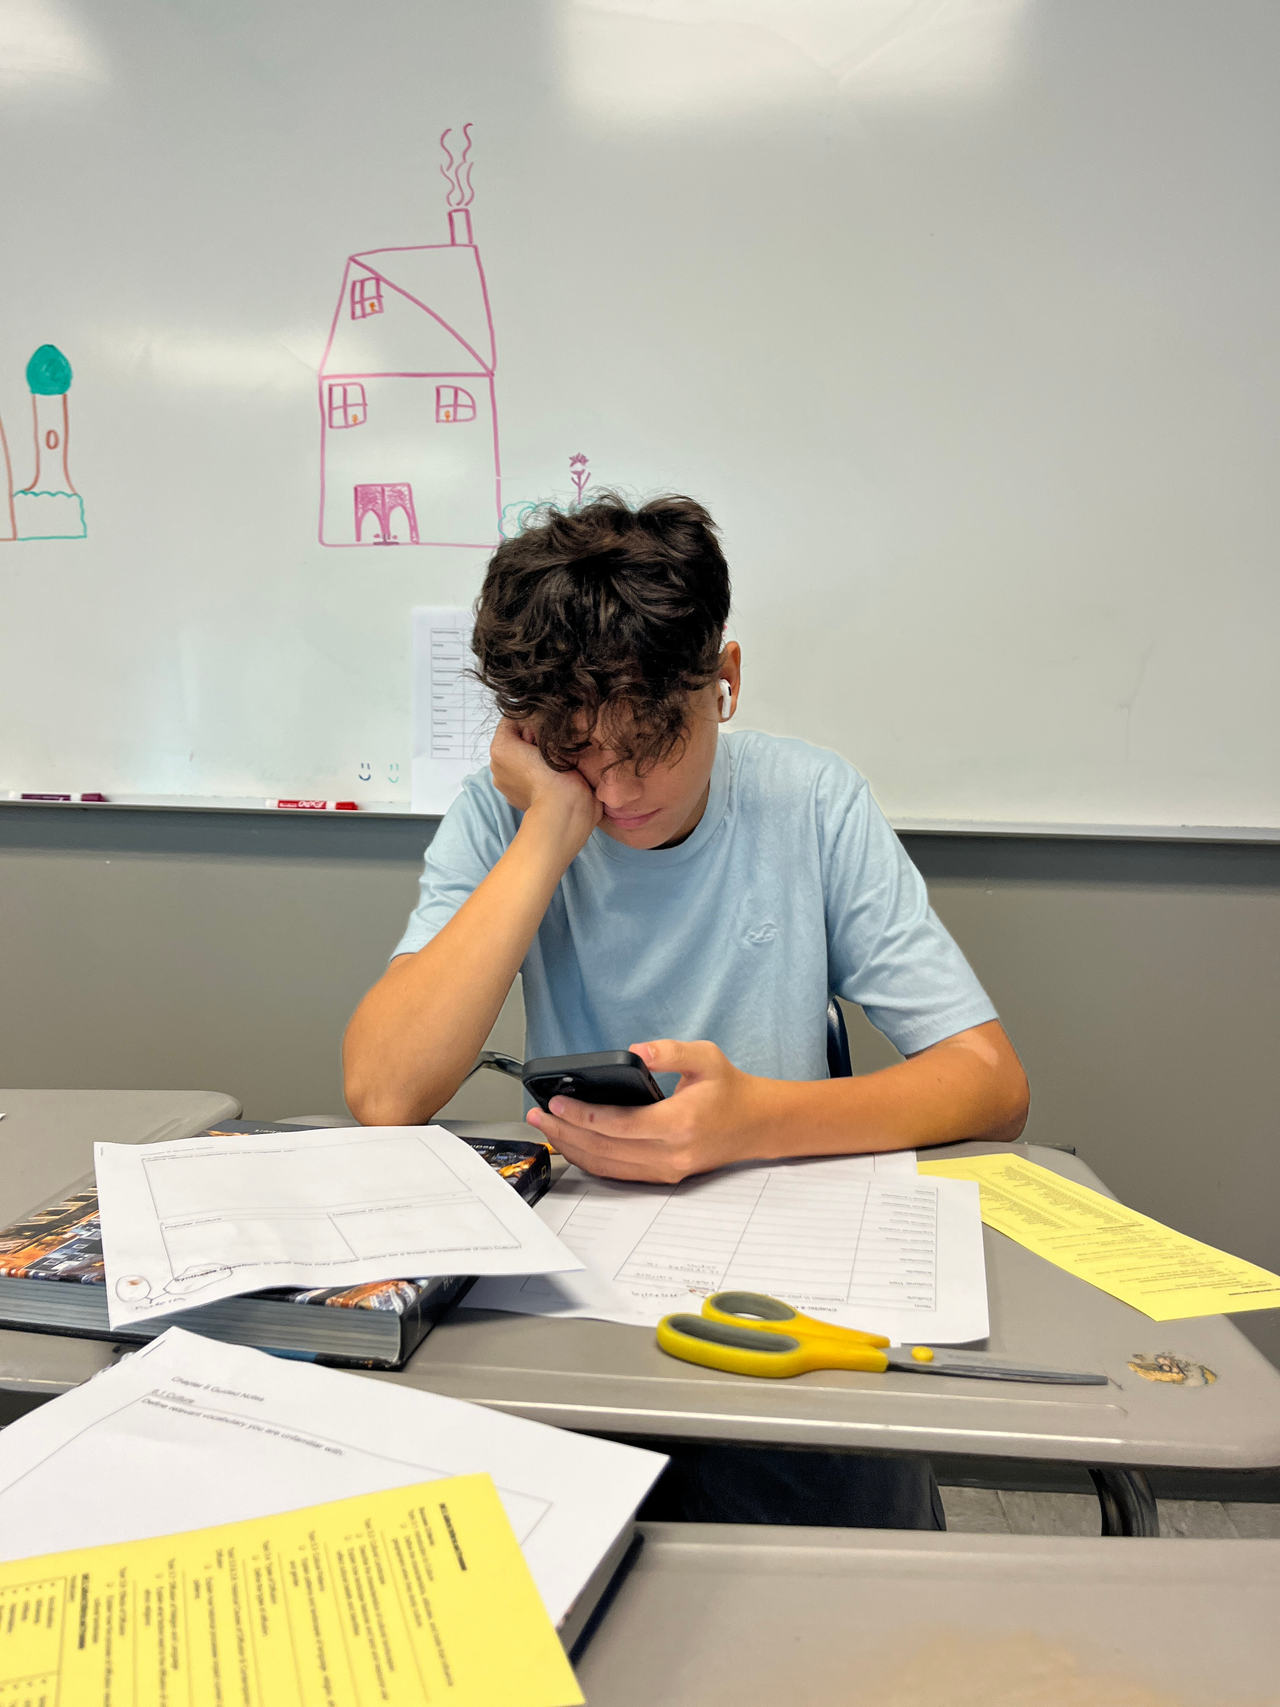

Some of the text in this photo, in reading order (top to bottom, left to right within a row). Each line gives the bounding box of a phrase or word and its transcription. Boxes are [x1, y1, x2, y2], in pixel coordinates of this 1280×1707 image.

[171, 1376, 202, 1388] Chapter
[210, 1386, 241, 1396] Guided
[240, 1393, 264, 1402] Notes
[141, 1399, 168, 1409] Define
[168, 1406, 202, 1416] relevant
[202, 1414, 247, 1429] vocabulary
[247, 1423, 264, 1431] you
[265, 1428, 280, 1436] are
[280, 1432, 323, 1449] unfamiliar
